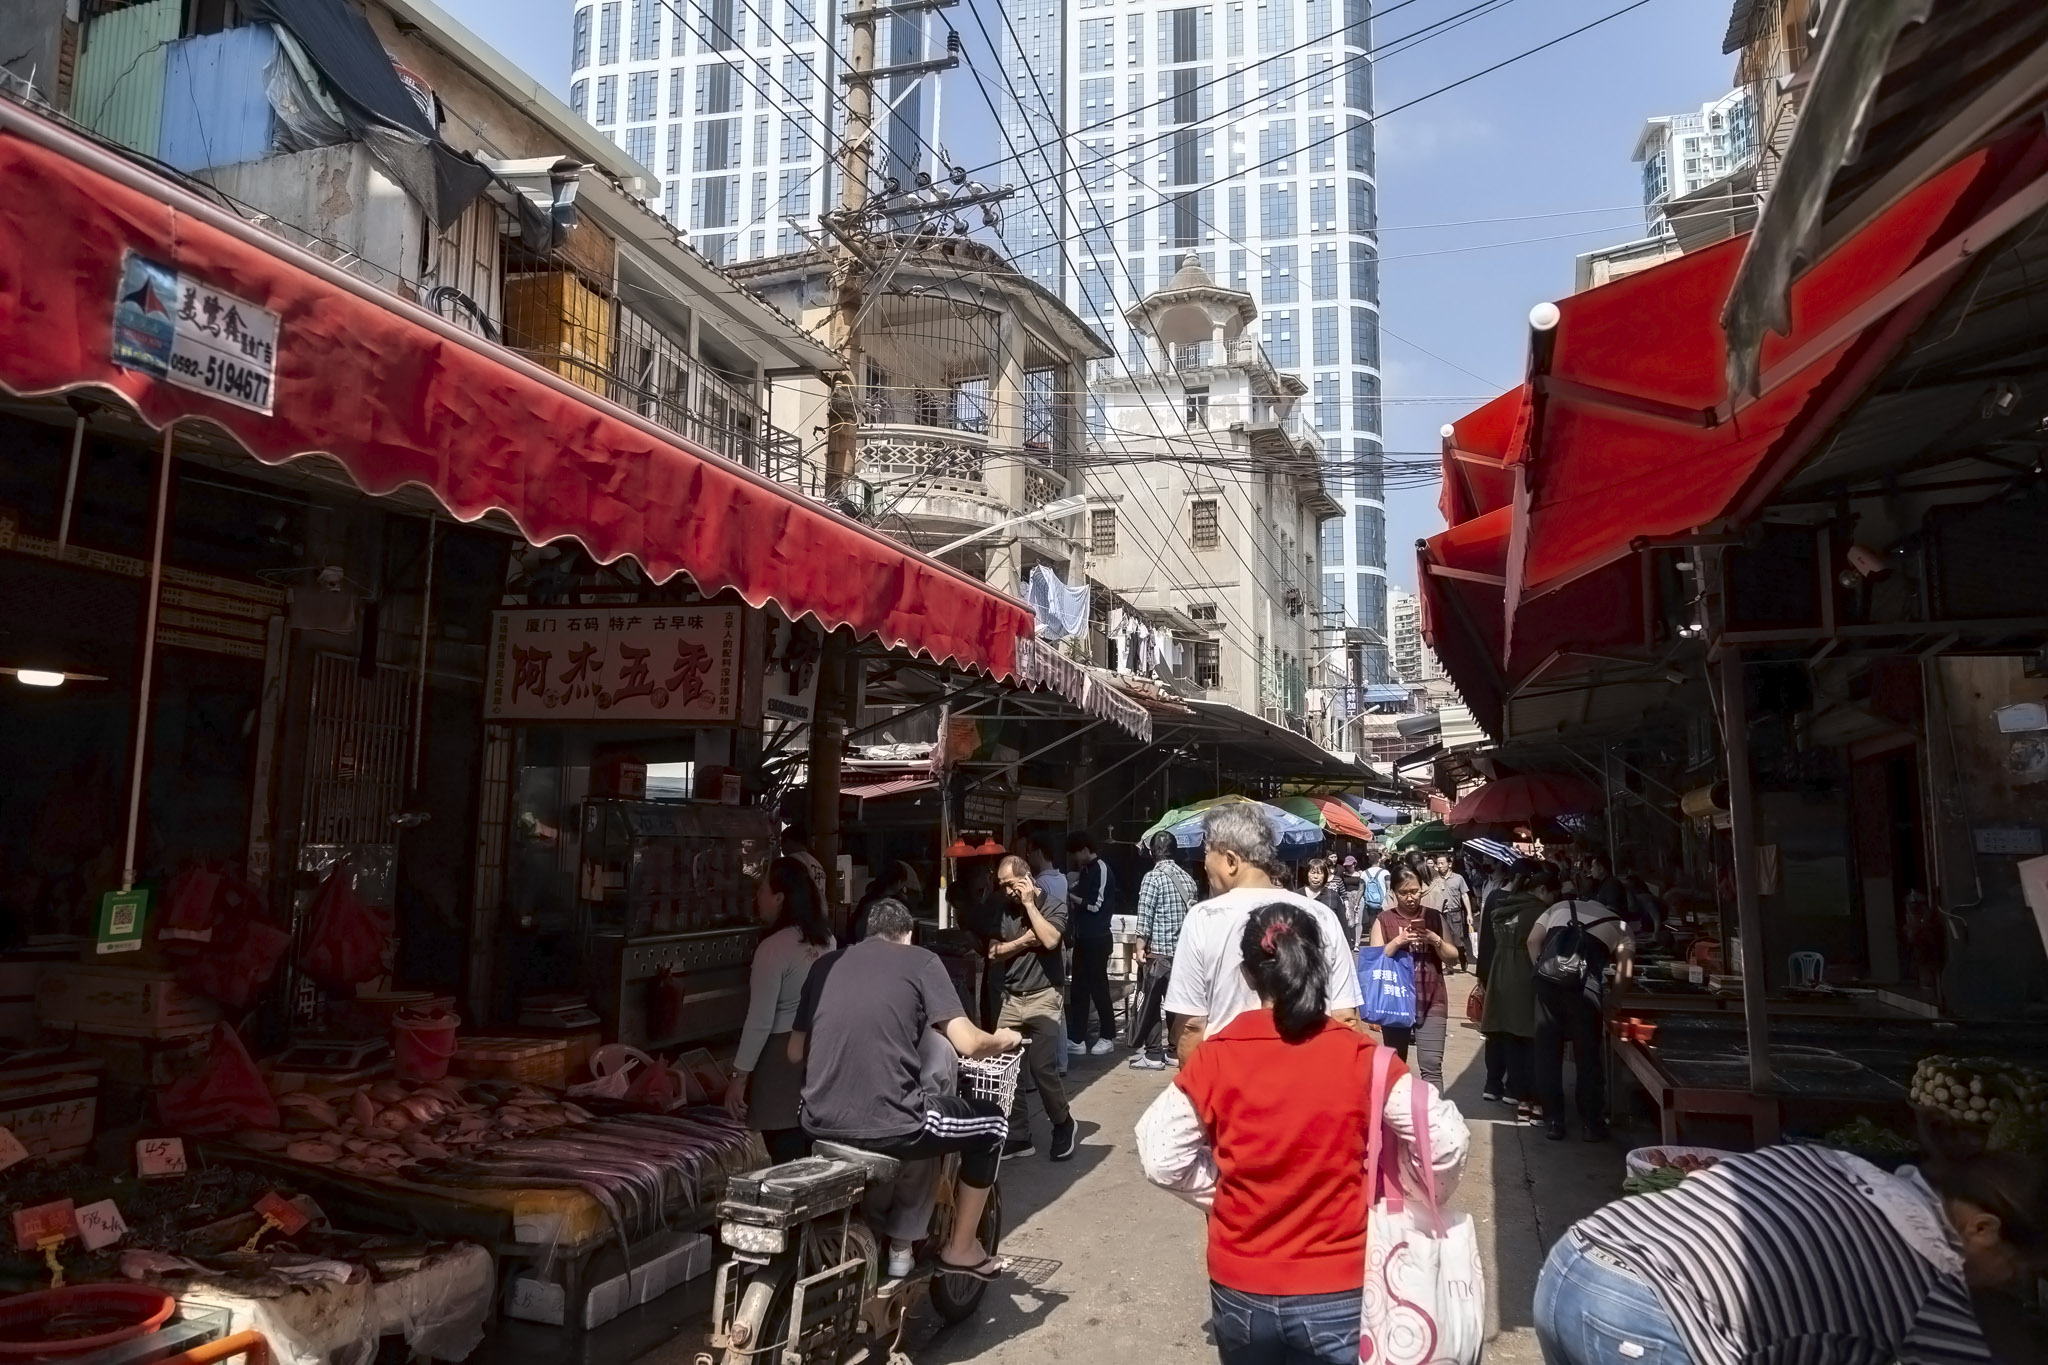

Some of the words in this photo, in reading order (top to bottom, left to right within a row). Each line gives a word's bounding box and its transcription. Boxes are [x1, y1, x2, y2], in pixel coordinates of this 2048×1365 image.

[170, 354, 270, 405] 0592-5194677
[525, 618, 557, 633] 厦门
[567, 617, 599, 632] 石码
[608, 616, 642, 631] 特产
[652, 615, 704, 631] 古早味
[511, 637, 714, 707] 阿杰五香
